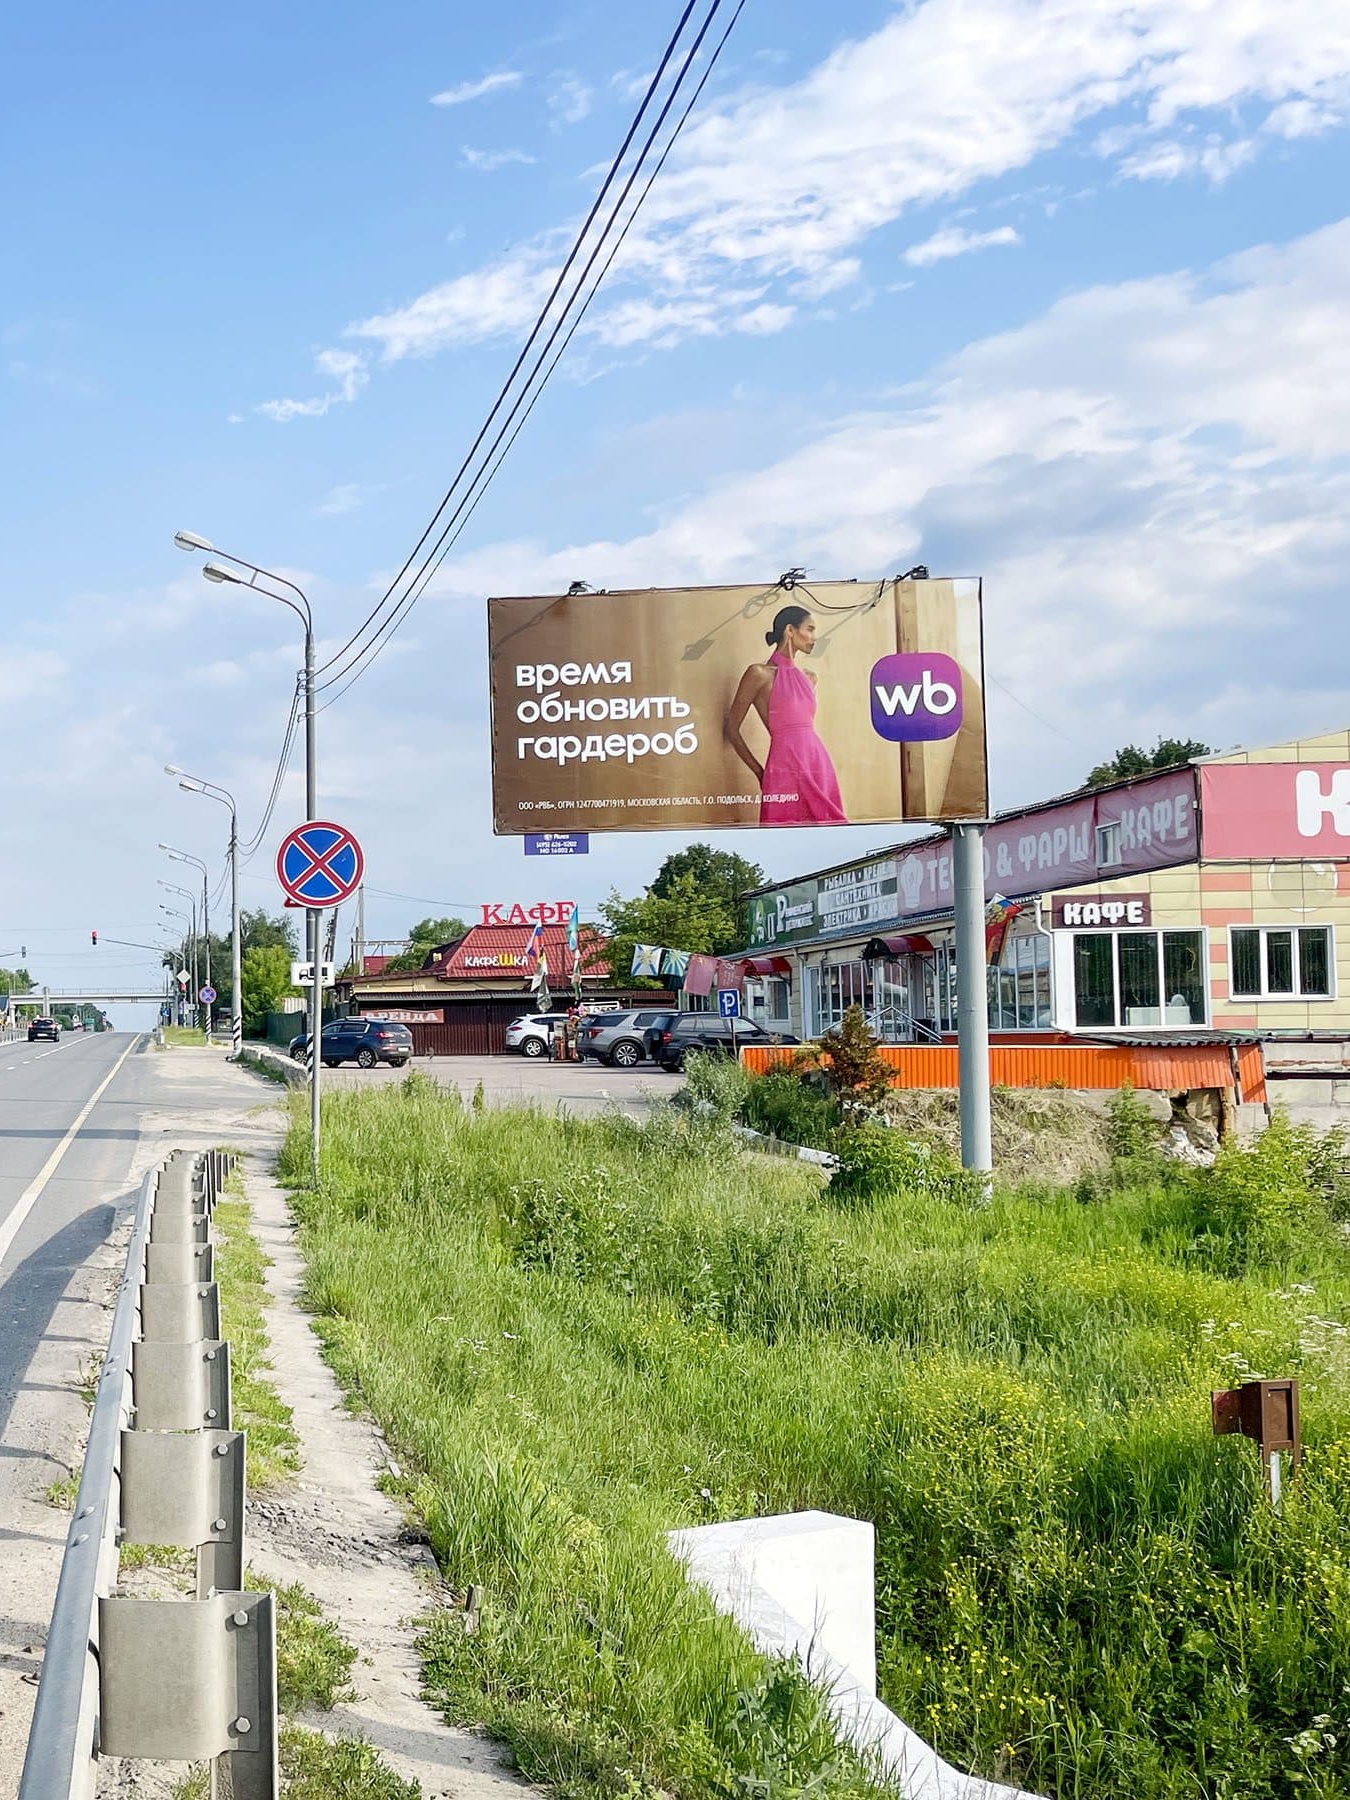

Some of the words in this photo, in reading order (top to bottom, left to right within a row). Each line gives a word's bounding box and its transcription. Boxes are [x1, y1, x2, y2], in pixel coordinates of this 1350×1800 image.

[516, 661, 632, 694] время
[875, 670, 957, 716] wb
[516, 691, 691, 724] обновить
[518, 723, 698, 766] гардероб
[518, 801, 534, 810] ООО
[557, 800, 575, 809] ОГРН
[627, 797, 671, 807] МОСКОВСКАЯ
[762, 793, 799, 803] КОЛЕДИНО
[1018, 821, 1090, 872] ФАРШ
[1120, 794, 1189, 850] КАФЕ
[824, 871, 857, 891] РЫБАЛКА
[835, 882, 882, 905] САНТЕХНИКА
[480, 901, 575, 925] КАФЕ
[823, 905, 863, 928] ЭЛЕКТРИКА
[1063, 901, 1144, 925] КАФЕ
